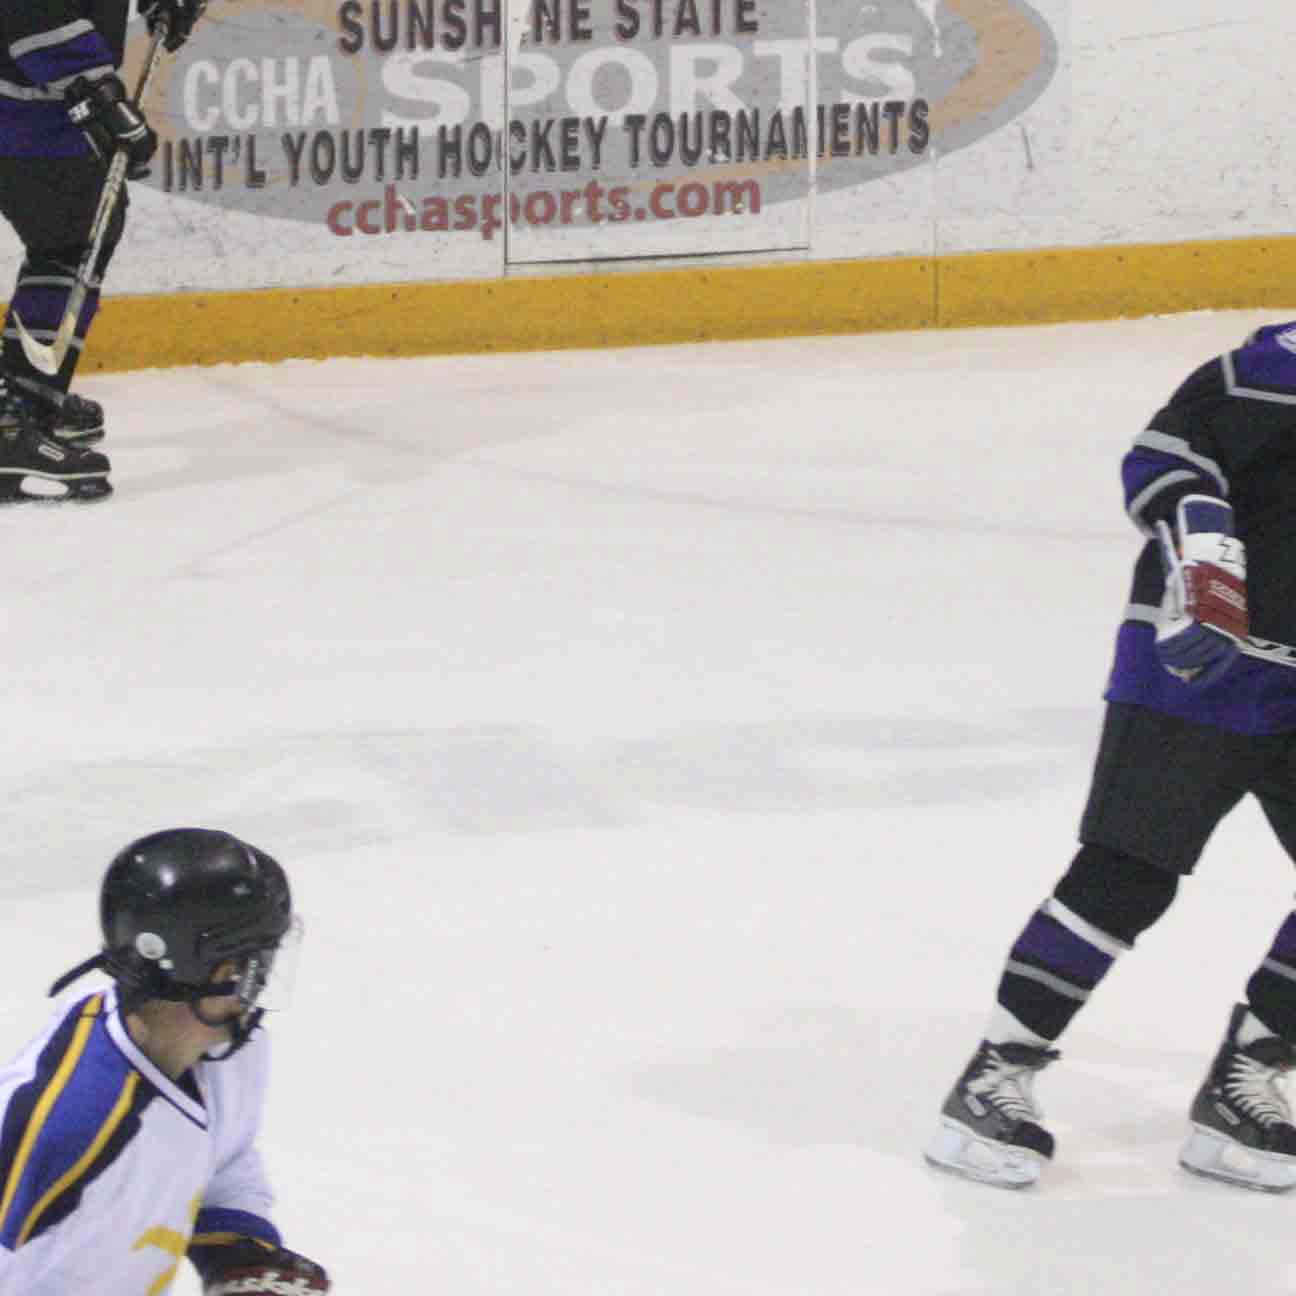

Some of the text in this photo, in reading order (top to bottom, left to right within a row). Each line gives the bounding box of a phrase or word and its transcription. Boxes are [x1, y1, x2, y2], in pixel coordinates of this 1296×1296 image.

[182, 32, 917, 136] CCHA SPORTS
[162, 98, 931, 193] INT'L YOUTH HOCKEY TOURNAMENTS
[326, 176, 762, 240] cchasports.com
